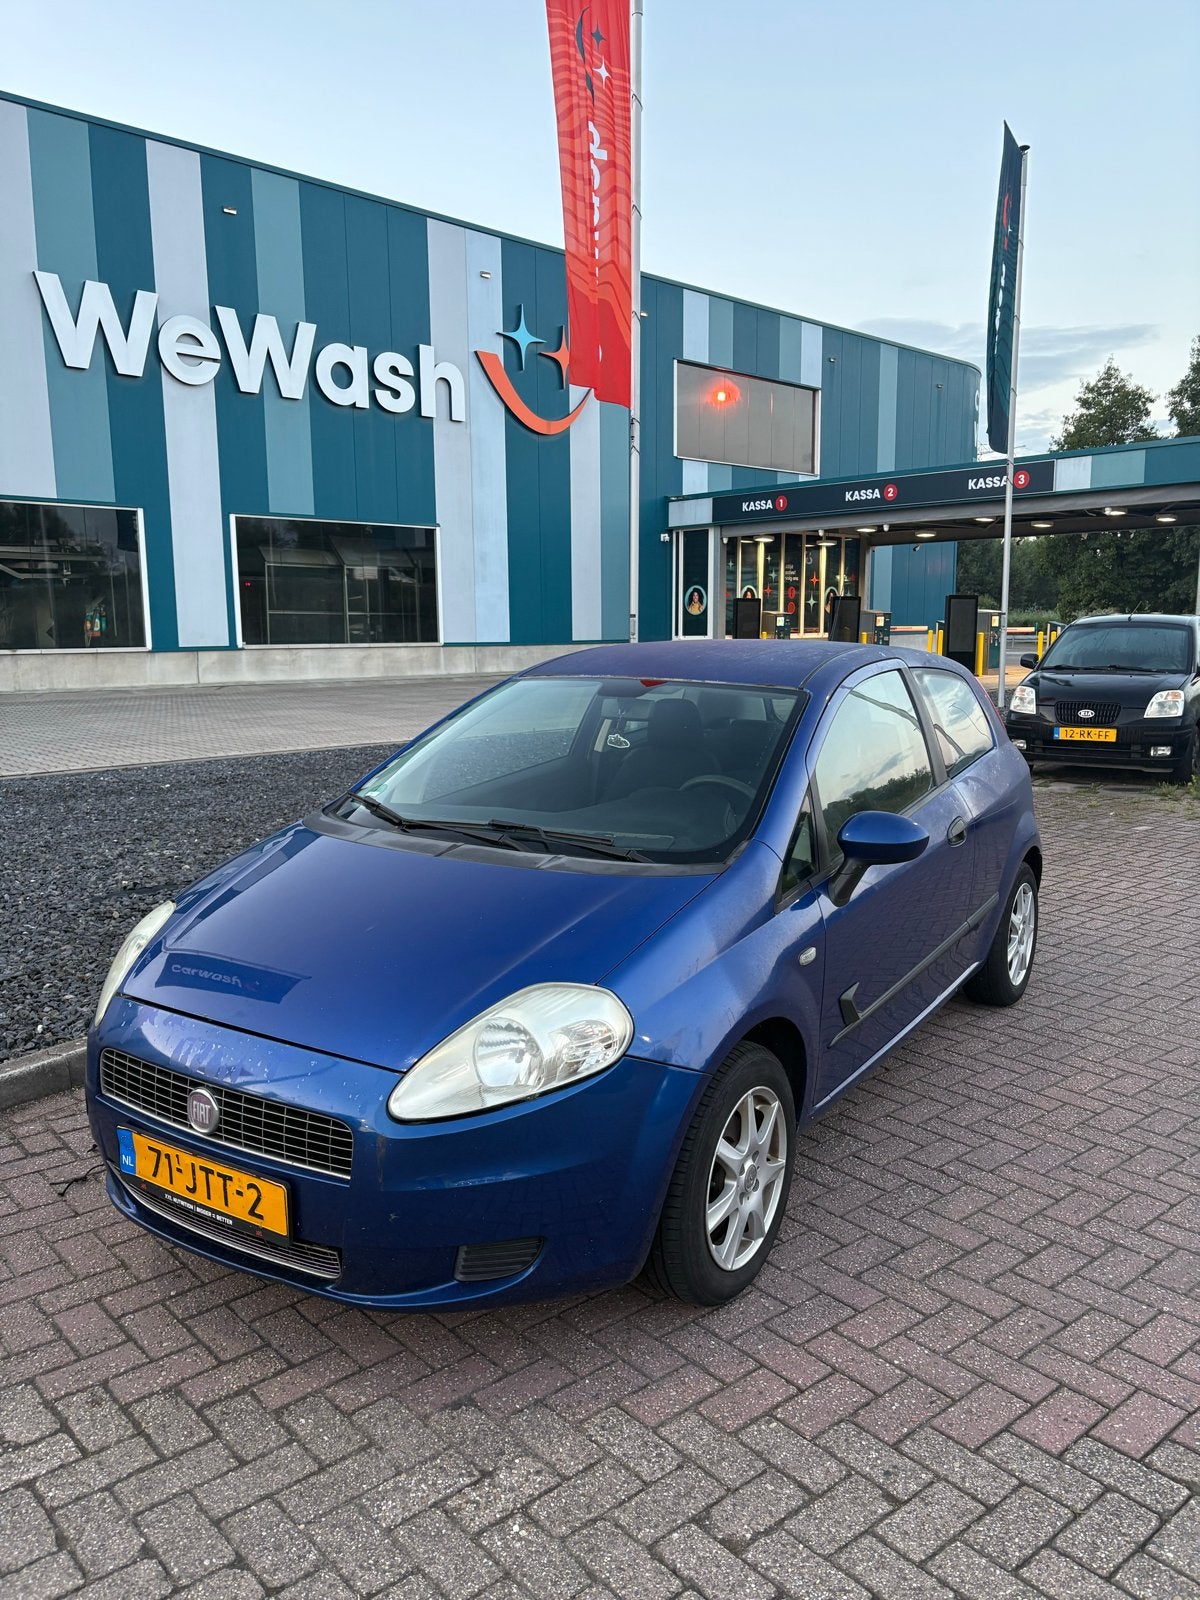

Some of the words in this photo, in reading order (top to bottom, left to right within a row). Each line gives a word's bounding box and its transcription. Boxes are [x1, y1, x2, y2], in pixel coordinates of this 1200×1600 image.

[33, 270, 466, 423] WeWash
[968, 475, 1008, 490] KASSA
[1018, 474, 1025, 485] 3
[845, 488, 881, 502] KASSA
[887, 487, 894, 497] 2
[742, 499, 773, 512] KASSA
[1065, 729, 1110, 739] 12-RK-FF
[193, 1100, 211, 1124] FIAT
[122, 1154, 134, 1167] NL
